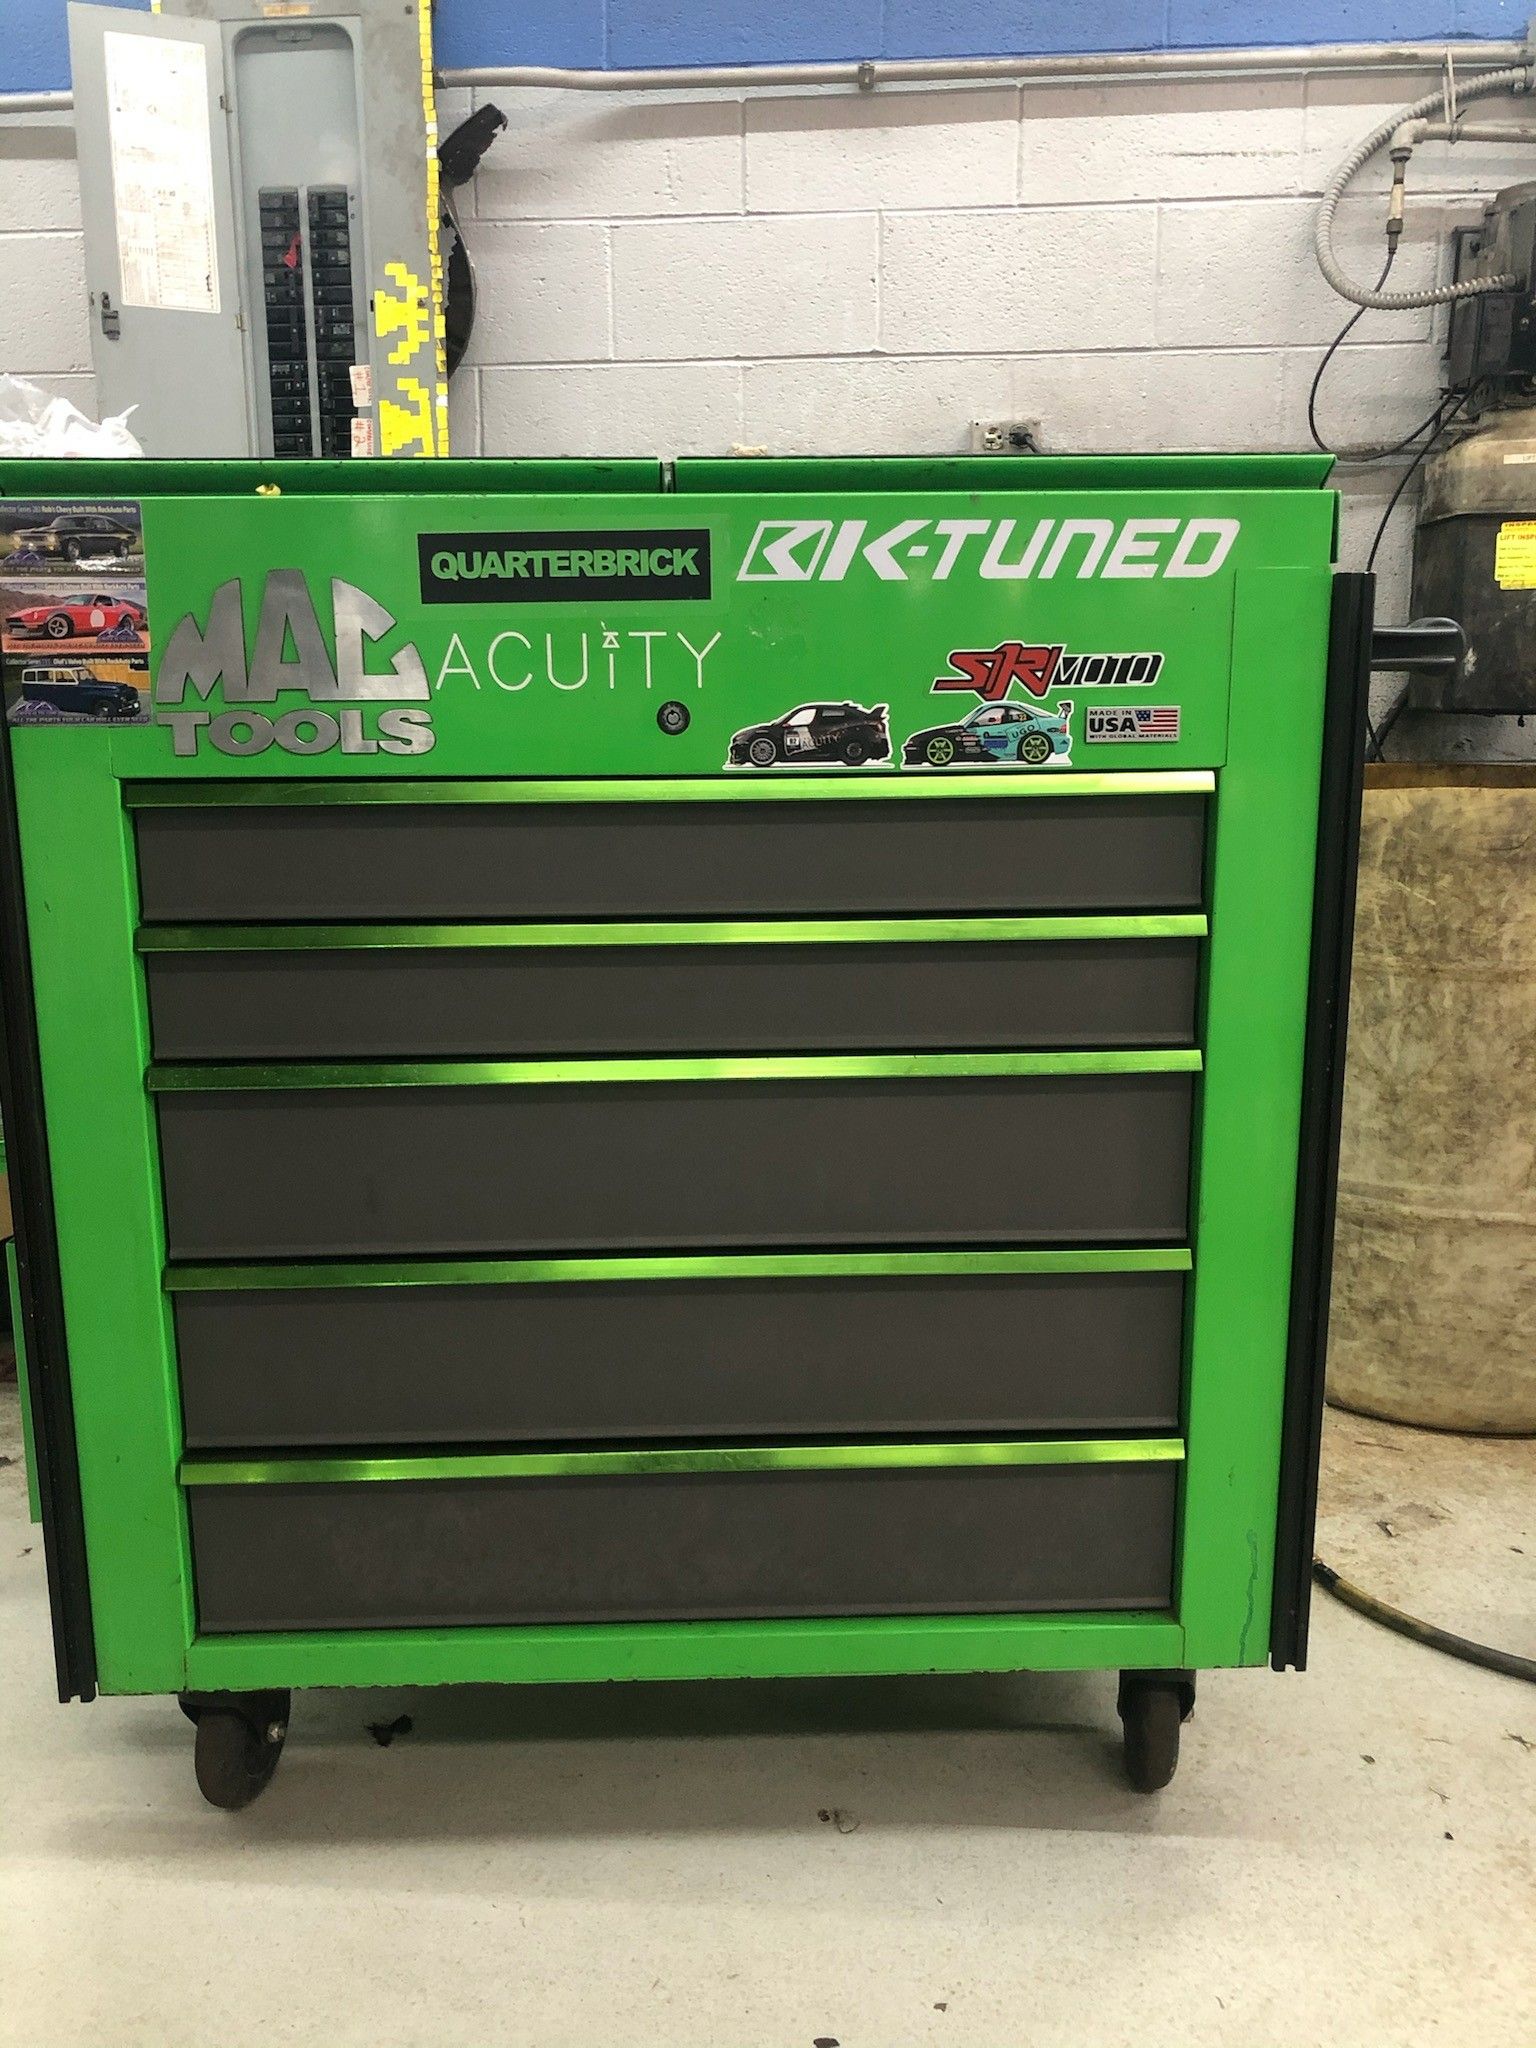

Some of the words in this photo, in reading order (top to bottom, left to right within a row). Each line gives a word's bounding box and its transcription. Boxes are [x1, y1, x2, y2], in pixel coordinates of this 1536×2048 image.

[430, 547, 700, 581] QUARTERBRICK
[156, 568, 432, 704] MAC
[155, 709, 436, 757] TOOLS
[1011, 724, 1036, 739] UGO
[1089, 717, 1137, 733] USA
